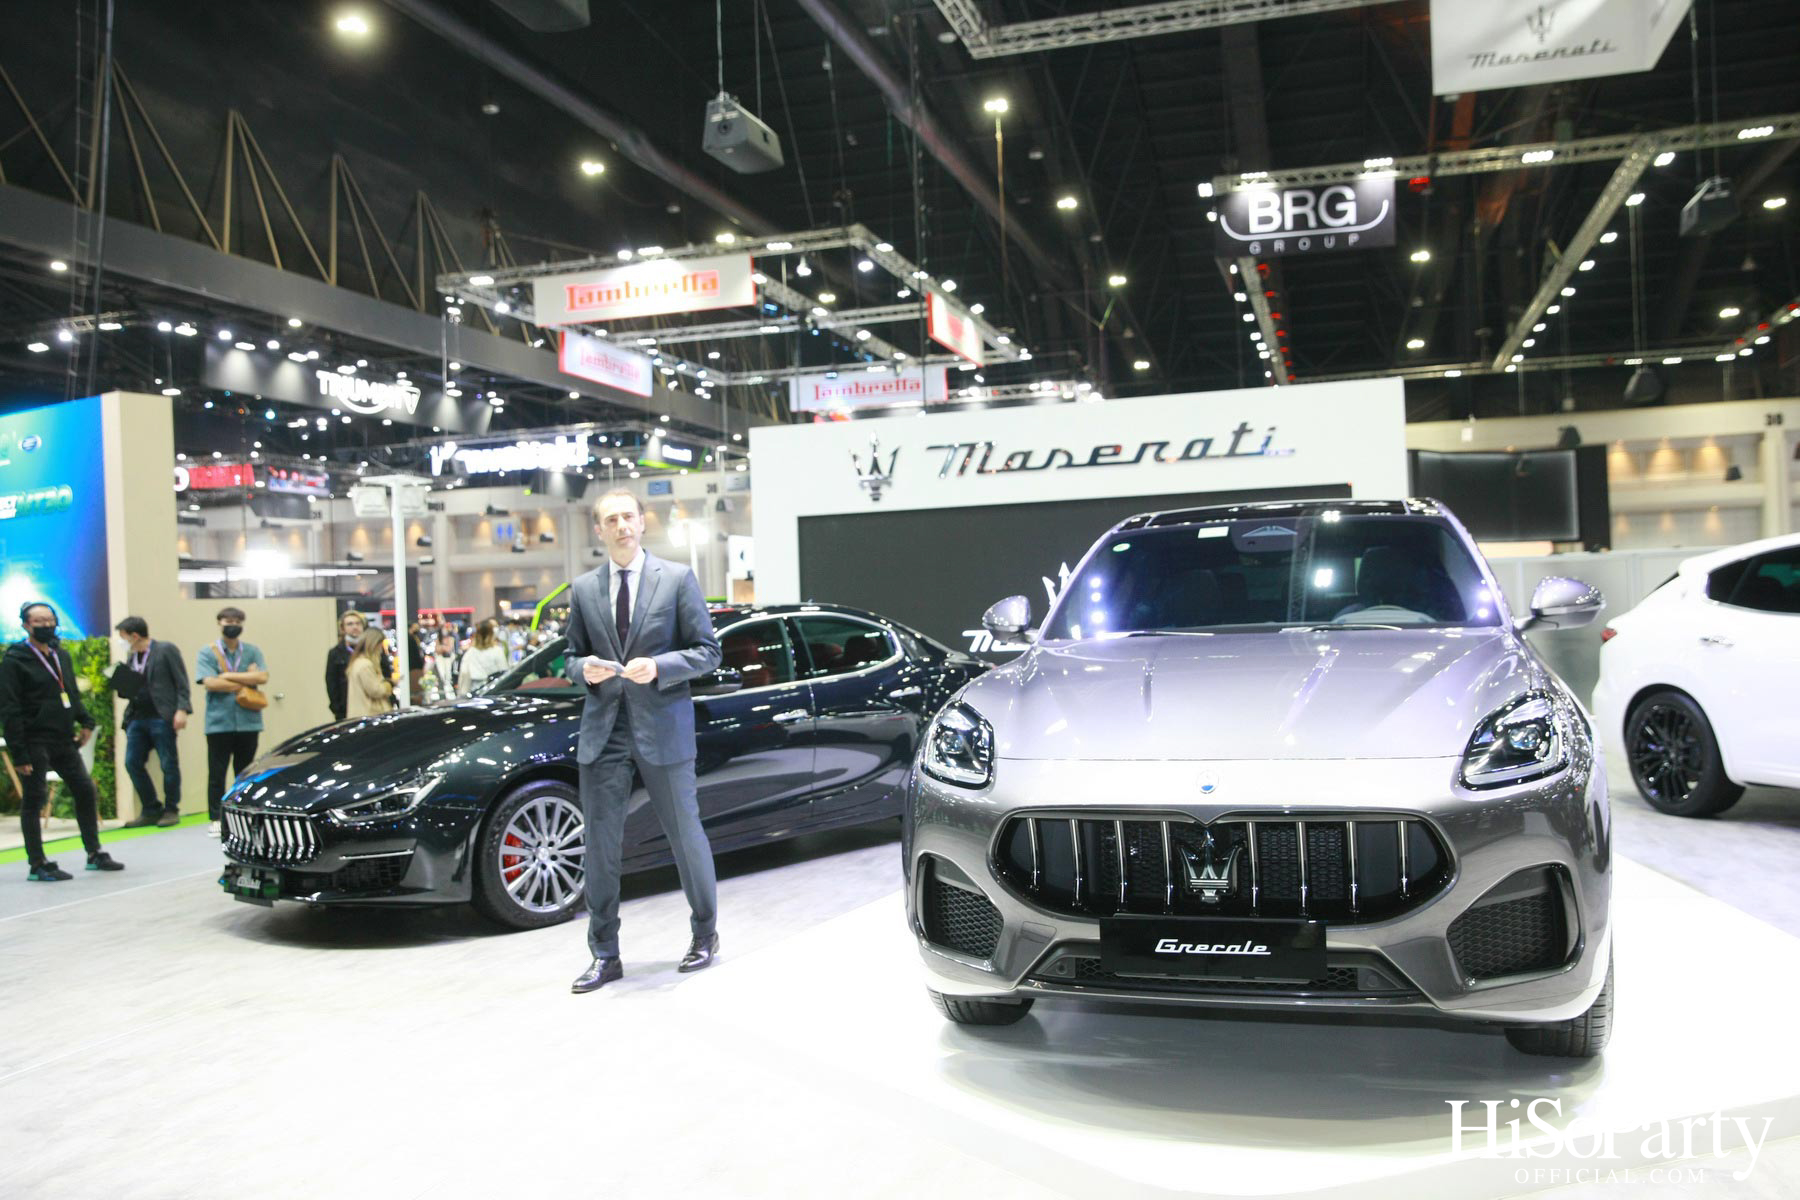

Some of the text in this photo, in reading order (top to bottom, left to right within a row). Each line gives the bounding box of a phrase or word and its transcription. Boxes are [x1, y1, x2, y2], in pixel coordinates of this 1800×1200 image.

[1467, 40, 1616, 69] Maserati
[1249, 185, 1357, 233] BRG
[1250, 233, 1360, 255] GROUP
[566, 270, 720, 311] Lambretta
[814, 378, 922, 401] Lambretta
[926, 422, 1296, 479] Maserati
[1154, 938, 1272, 955] Grecale
